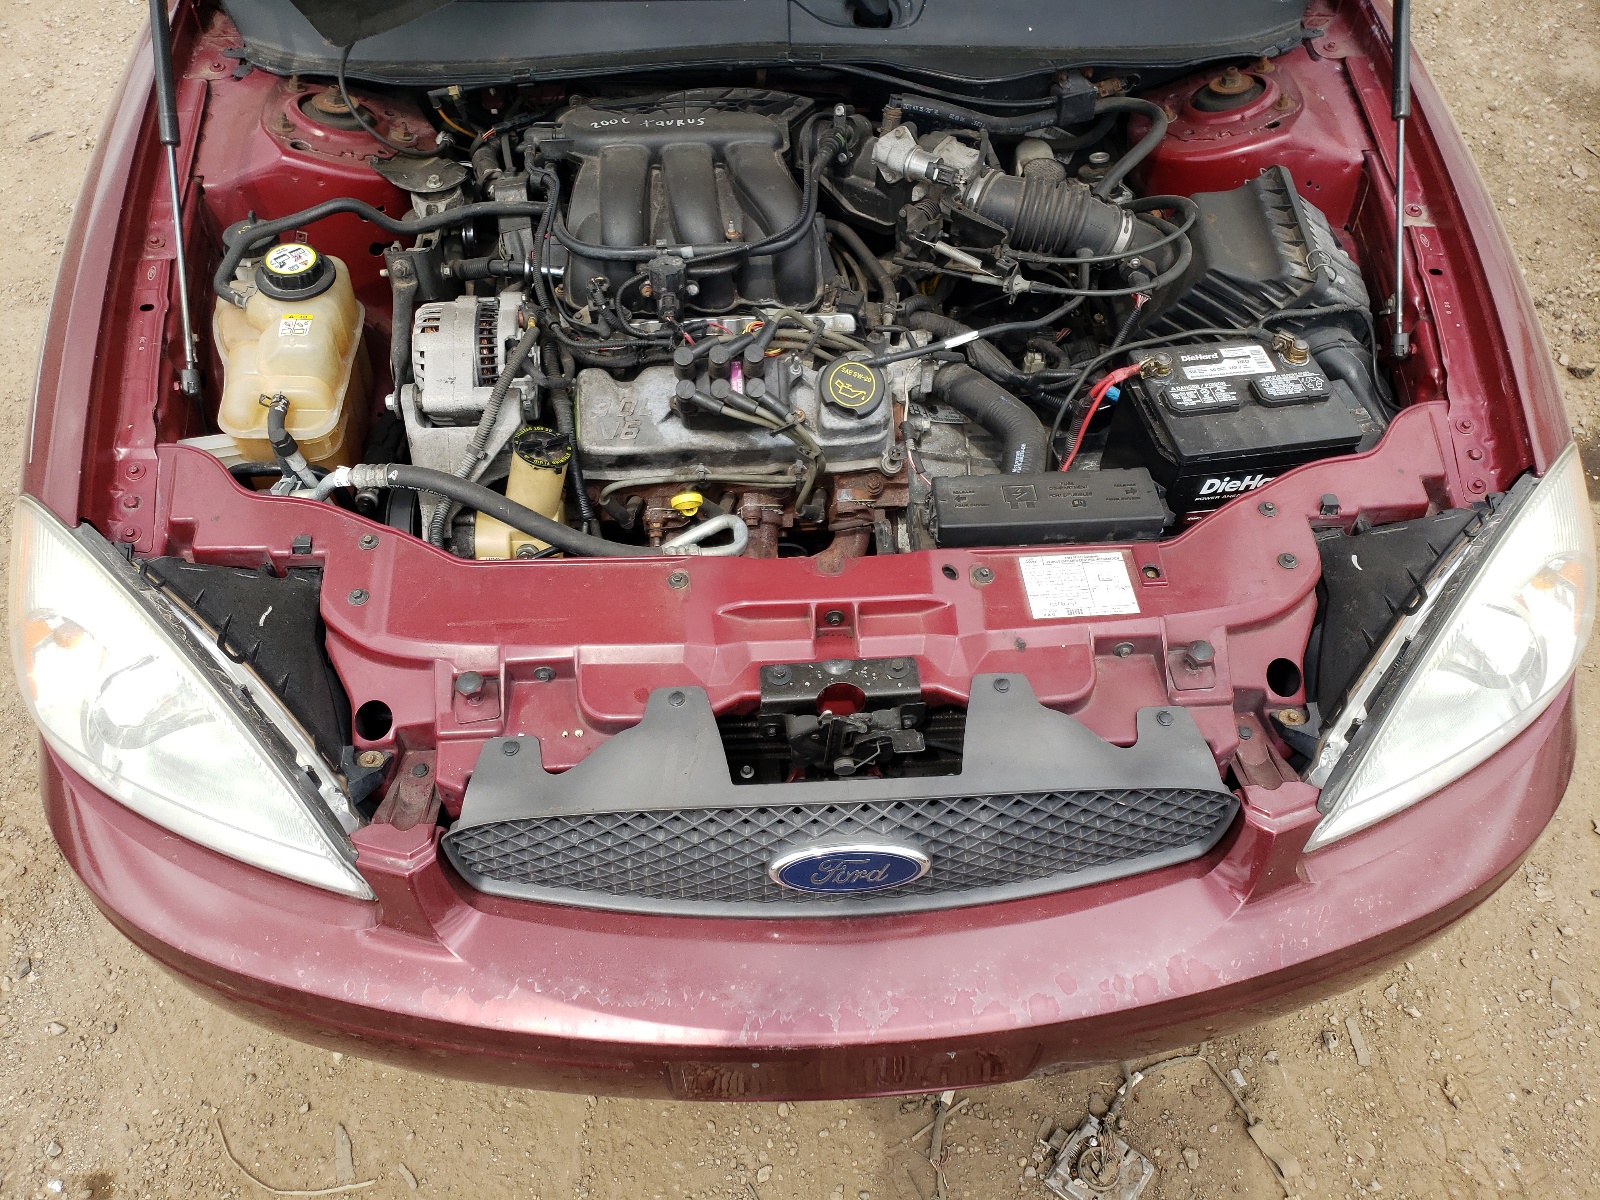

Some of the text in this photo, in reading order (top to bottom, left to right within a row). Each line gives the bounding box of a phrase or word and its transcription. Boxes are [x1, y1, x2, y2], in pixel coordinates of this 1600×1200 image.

[1180, 352, 1219, 362] DieHard
[841, 366, 872, 383] SAE 5W-20
[600, 419, 643, 440] V6
[1199, 473, 1278, 495] DieH
[810, 858, 891, 885] Ford
